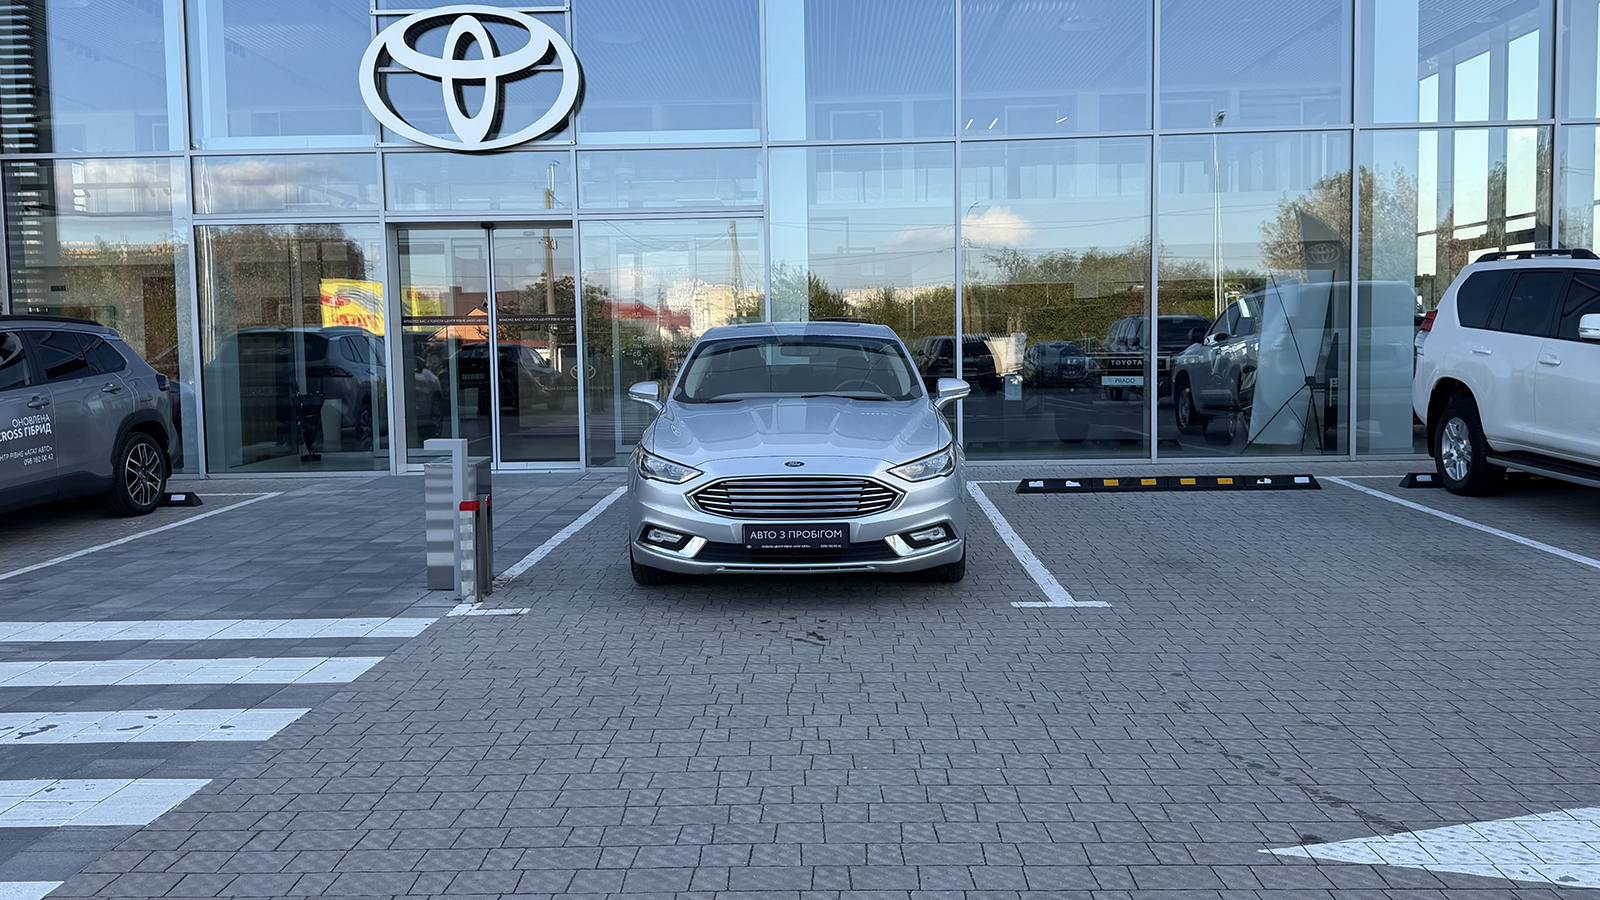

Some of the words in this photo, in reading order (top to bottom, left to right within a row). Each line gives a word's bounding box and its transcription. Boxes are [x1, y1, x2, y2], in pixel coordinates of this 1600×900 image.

[11, 413, 51, 428] ОНОВЛЕНА
[24, 422, 52, 437] ГІБРИД
[750, 531, 777, 539] АВТО
[788, 529, 843, 539] ПРОБІГОМ
